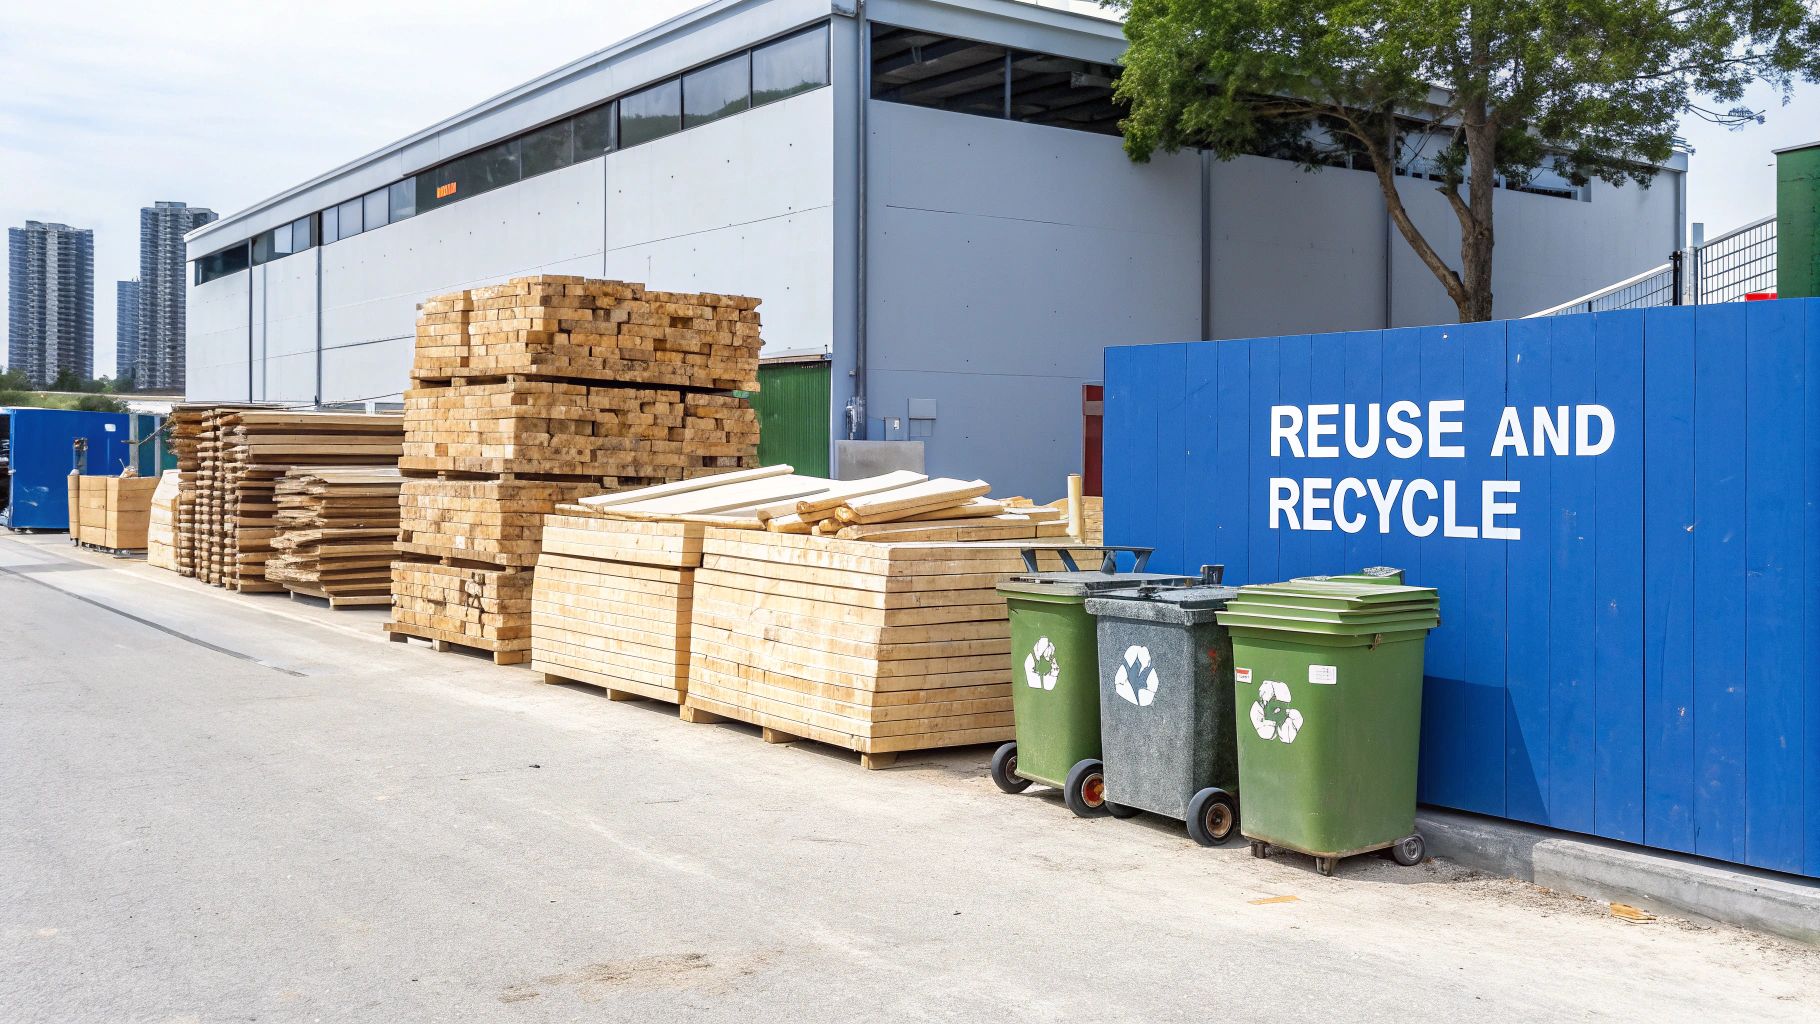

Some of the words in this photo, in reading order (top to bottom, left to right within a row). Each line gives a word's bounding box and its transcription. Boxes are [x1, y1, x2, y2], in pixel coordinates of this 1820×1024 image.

[1270, 400, 1465, 459] REUSE
[1490, 404, 1615, 457] AND
[1269, 477, 1521, 540] RECYCLE
